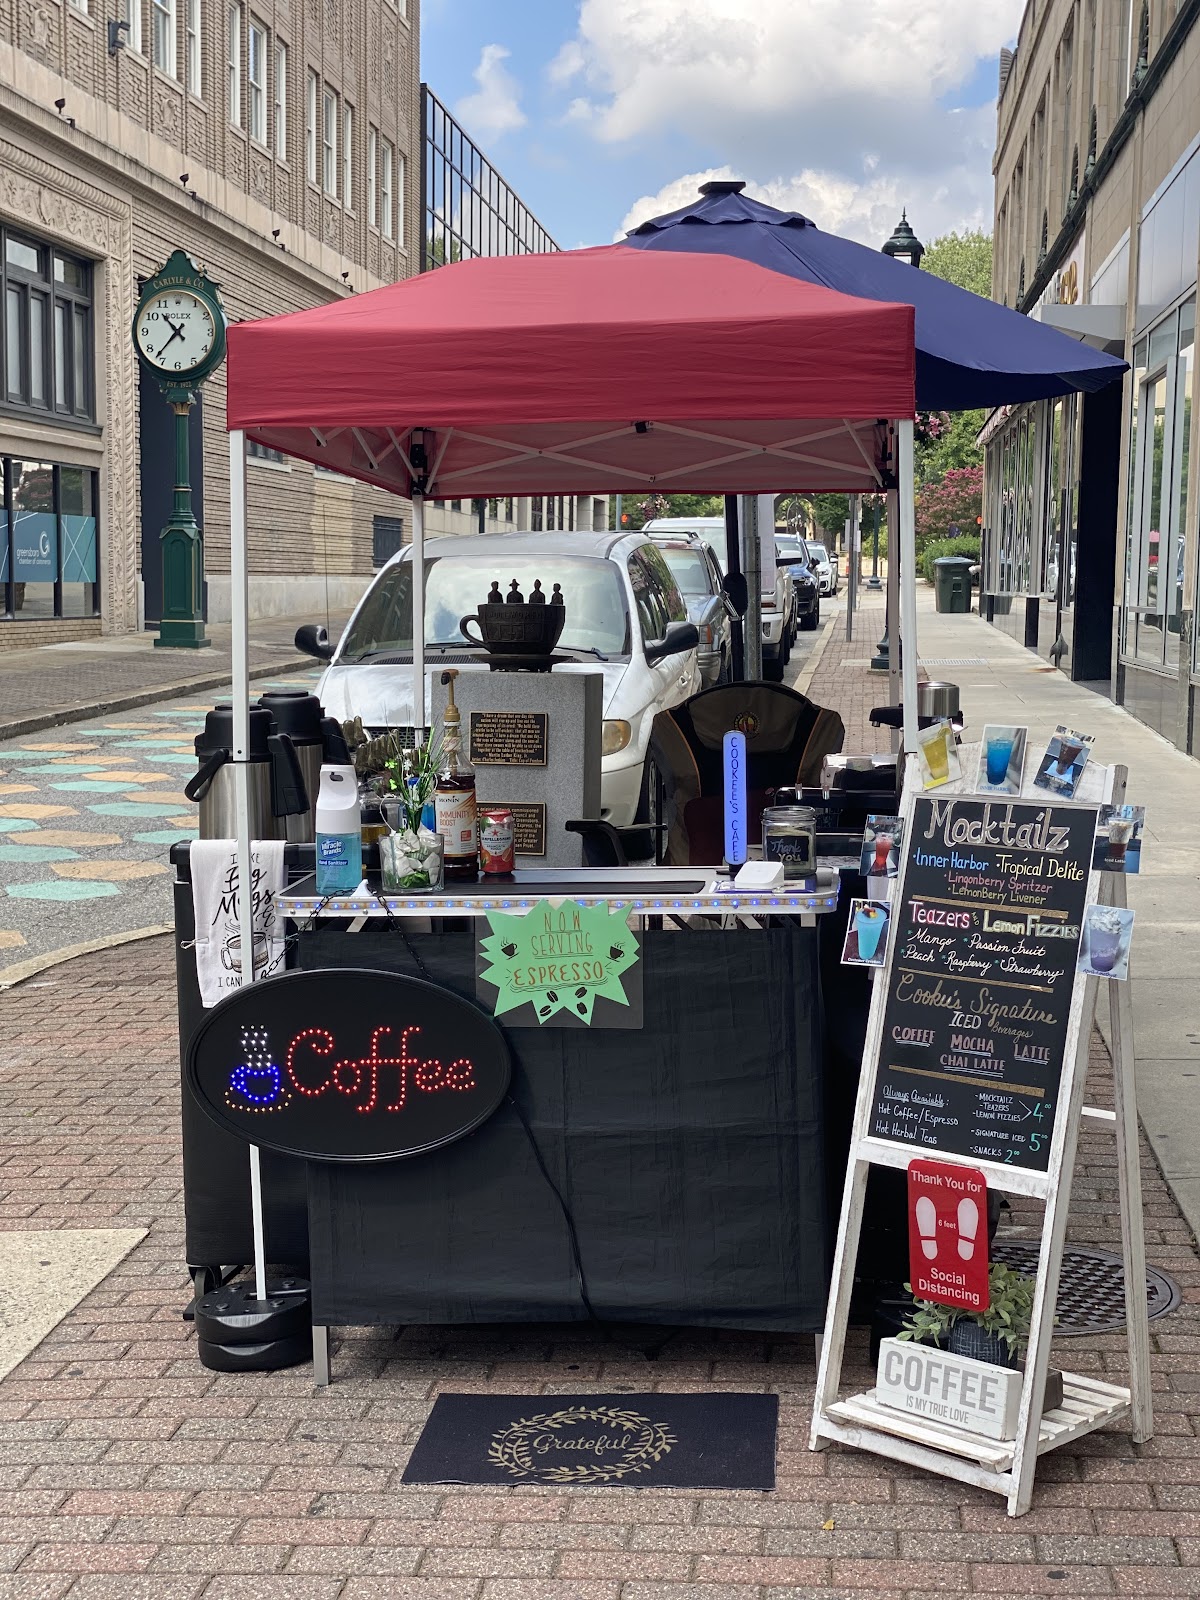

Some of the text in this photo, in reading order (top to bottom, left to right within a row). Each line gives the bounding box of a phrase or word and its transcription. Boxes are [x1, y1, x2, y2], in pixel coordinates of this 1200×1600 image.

[152, 276, 184, 290] CARLYLE
[156, 300, 168, 308] 11
[146, 312, 160, 321] 10
[202, 312, 210, 321] 2
[141, 328, 149, 336] 9
[207, 328, 214, 337] 3
[146, 344, 154, 352] 8
[160, 358, 166, 366] 7
[174, 362, 182, 370] 6
[190, 358, 198, 366] 5
[16, 547, 40, 560] greensboro
[729, 736, 740, 862] COOKE'S CAFE
[440, 810, 470, 819] IMMUNITY
[924, 800, 1070, 850] Mocktailz
[321, 840, 342, 850] Miracle
[323, 847, 342, 856] Brands
[770, 838, 801, 854] Thank
[230, 853, 237, 864] I
[916, 847, 1084, 881] Inner Harbor Tropical Delite
[222, 866, 268, 893] Bg
[948, 871, 1052, 894] Lingonberry Spritzer
[1010, 892, 1046, 904] Livener
[212, 890, 276, 926] Mgs
[544, 910, 580, 932] NOW
[908, 900, 970, 929] Teazers
[971, 911, 980, 926] AND
[983, 910, 1026, 935] Lemon
[531, 932, 593, 956] SERVING
[908, 928, 1046, 956] Mango Passion Fruit
[903, 944, 1064, 984] Peach Raspberry Strawberry
[218, 976, 223, 988] I
[514, 961, 604, 986] ESPRESSO
[970, 988, 1058, 1027] Signature
[949, 1011, 982, 1029] ICED
[892, 1025, 1050, 1061] COFFEE MOCHA LATTE
[287, 1026, 476, 1111] Coffee
[940, 1054, 1006, 1071] CHAI LATTE
[883, 1085, 910, 1102] Always
[878, 1102, 959, 1127] Hot Coffee/Espresso
[997, 1112, 1020, 1122] FIZZIES
[876, 1120, 938, 1144] Hot Herbal Teas
[1012, 1134, 1026, 1142] ICED
[911, 1170, 982, 1193] Thank You for
[944, 1220, 956, 1230] feet
[930, 1267, 966, 1285] Social
[918, 1278, 980, 1305] Distancing
[884, 1350, 999, 1414] COFFEE
[906, 1395, 970, 1424] IS MY TRUE LOVE
[532, 1434, 632, 1455] Grateful
